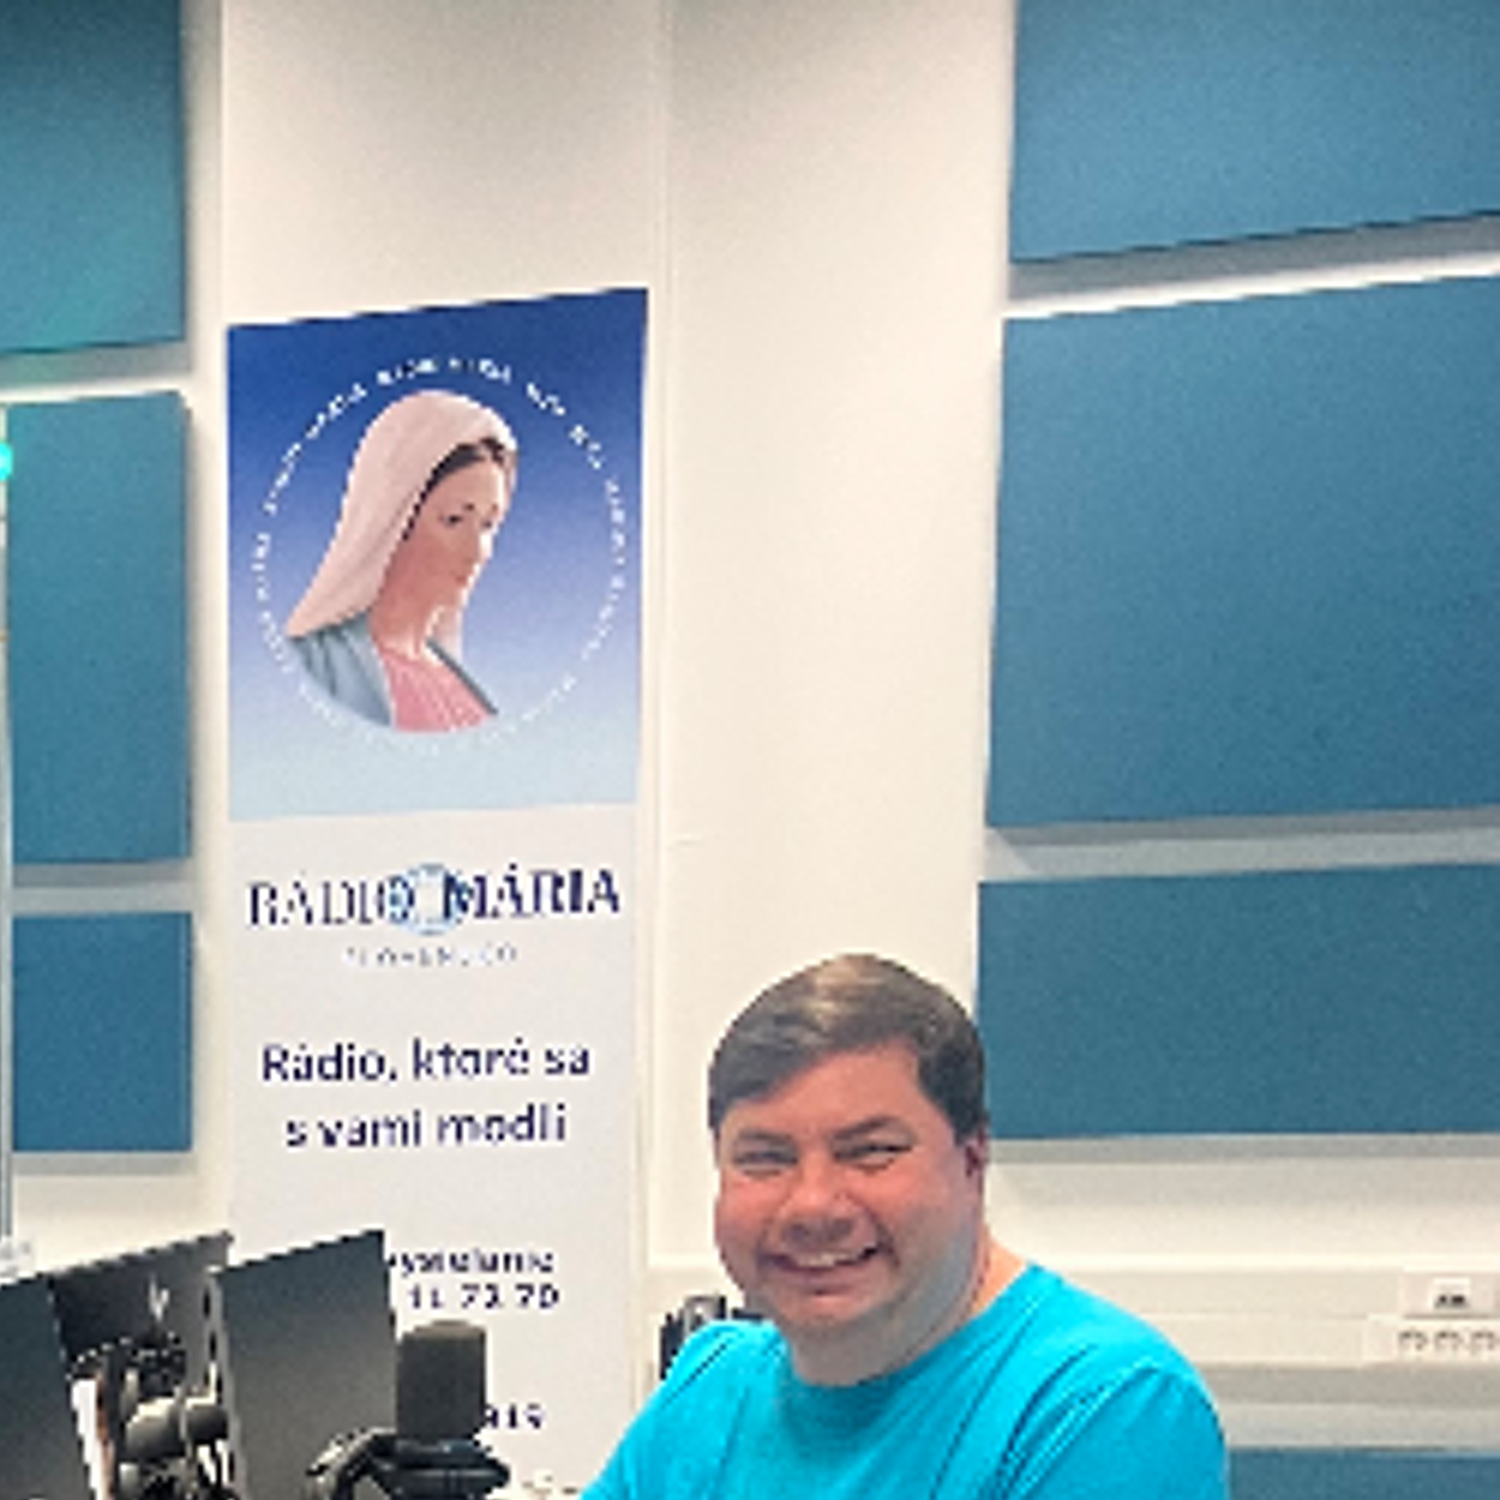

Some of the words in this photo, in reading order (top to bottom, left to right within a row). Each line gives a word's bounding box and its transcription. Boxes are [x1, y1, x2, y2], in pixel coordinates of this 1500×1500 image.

[443, 863, 622, 919] MÁRIA
[412, 1036, 530, 1080] ktoré
[544, 1045, 591, 1076] sa
[318, 1109, 422, 1147] vami
